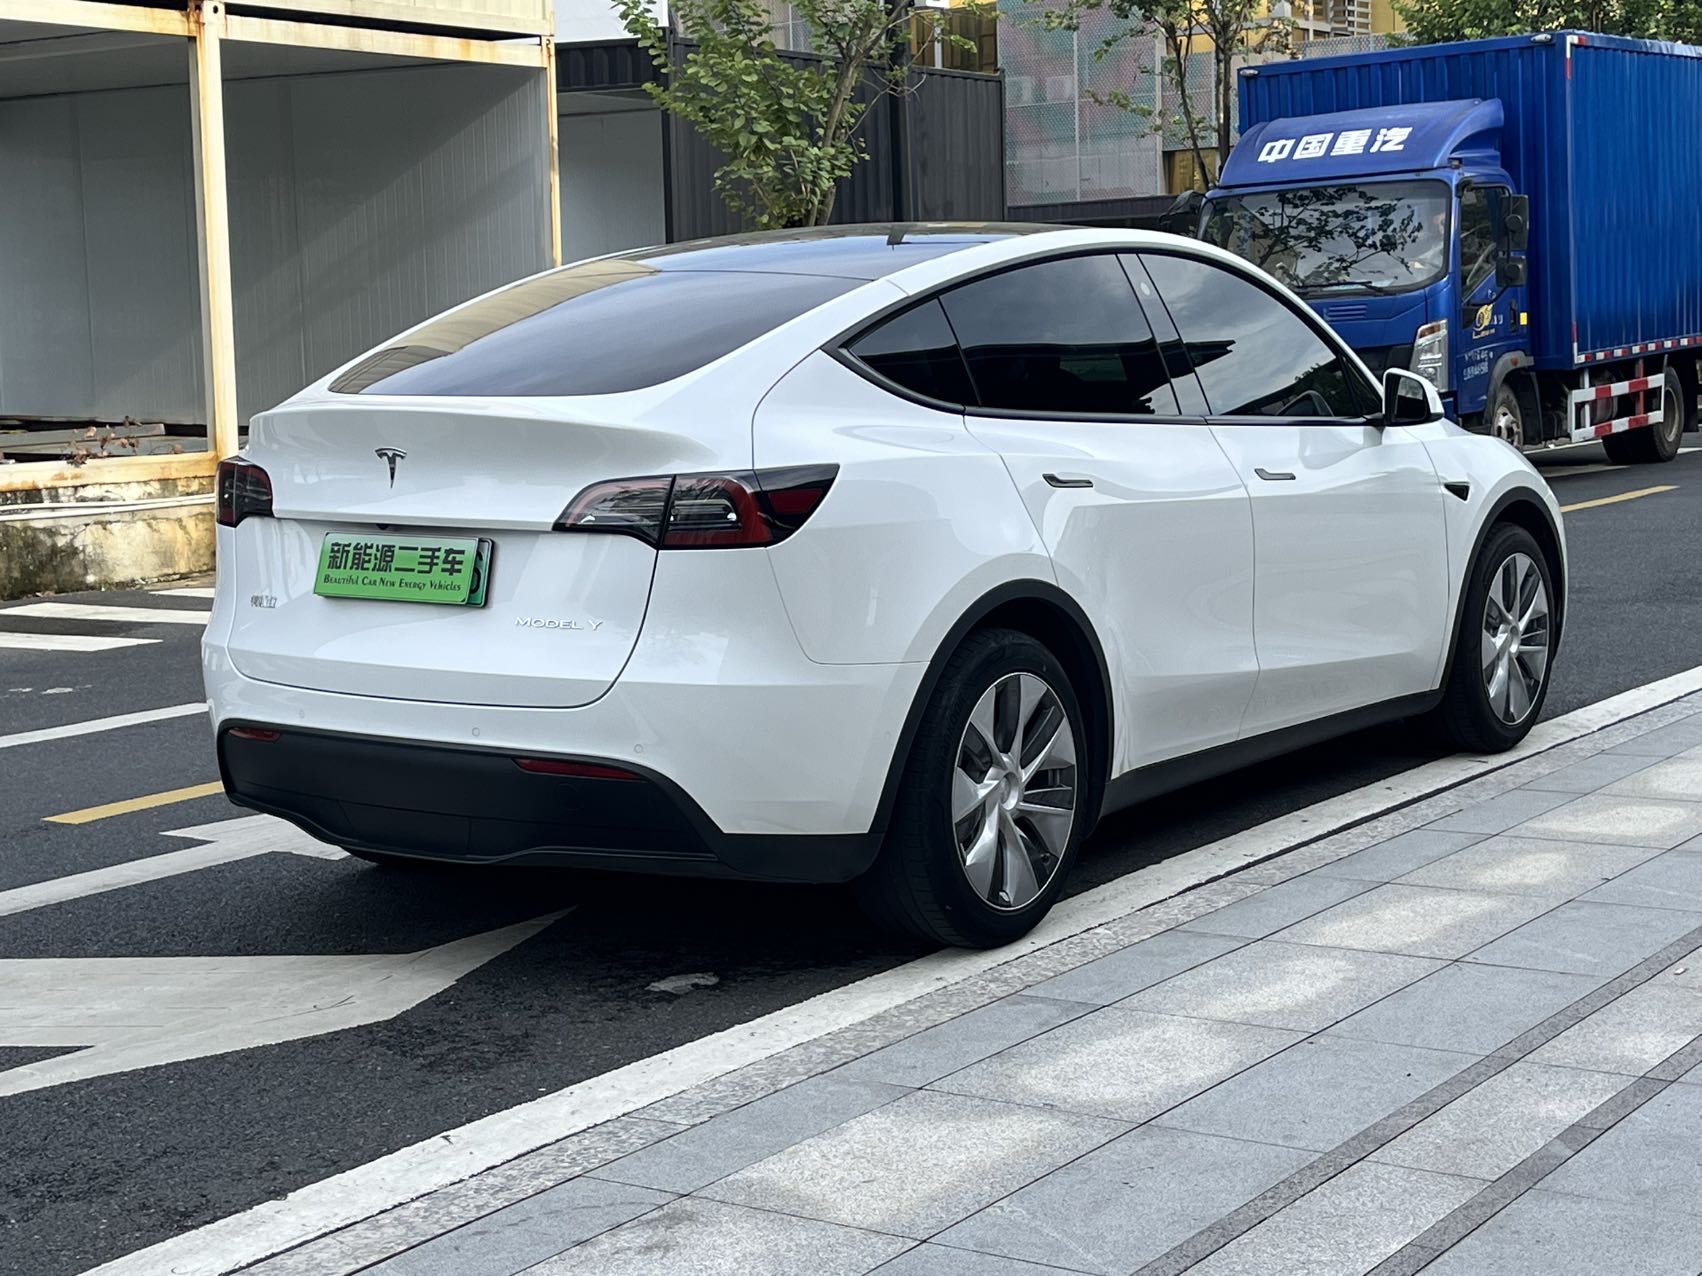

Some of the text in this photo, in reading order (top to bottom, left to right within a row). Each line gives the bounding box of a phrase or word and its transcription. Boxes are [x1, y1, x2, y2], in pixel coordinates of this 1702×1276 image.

[1257, 127, 1413, 163] 中国重汽
[327, 542, 465, 576] 新能源二手车
[515, 616, 604, 631] MODEL Y
